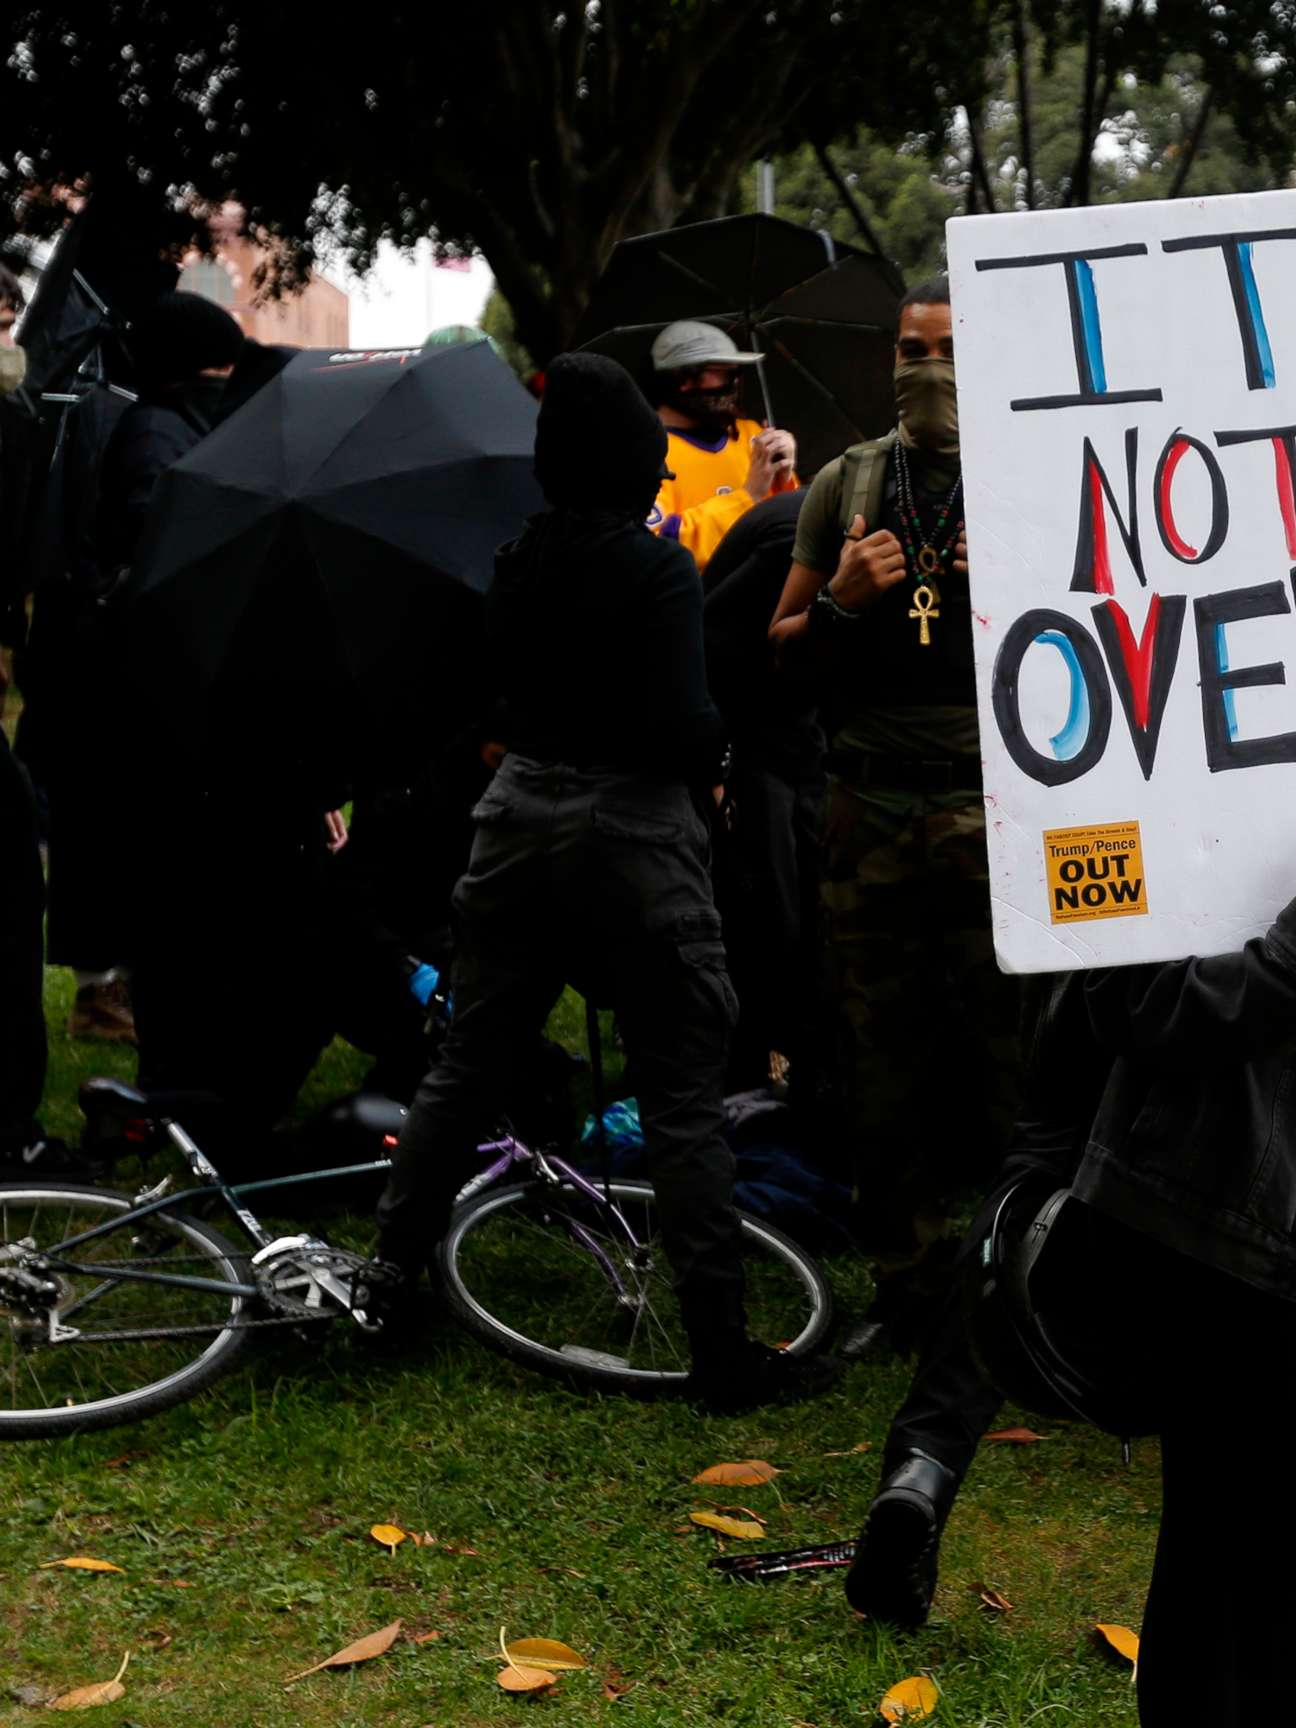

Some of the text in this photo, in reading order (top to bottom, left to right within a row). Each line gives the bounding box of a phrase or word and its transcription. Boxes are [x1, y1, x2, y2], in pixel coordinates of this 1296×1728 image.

[1049, 839, 1136, 858] Trump/Pence
[1059, 854, 1130, 884] OUT
[1054, 878, 1142, 911] NOW
